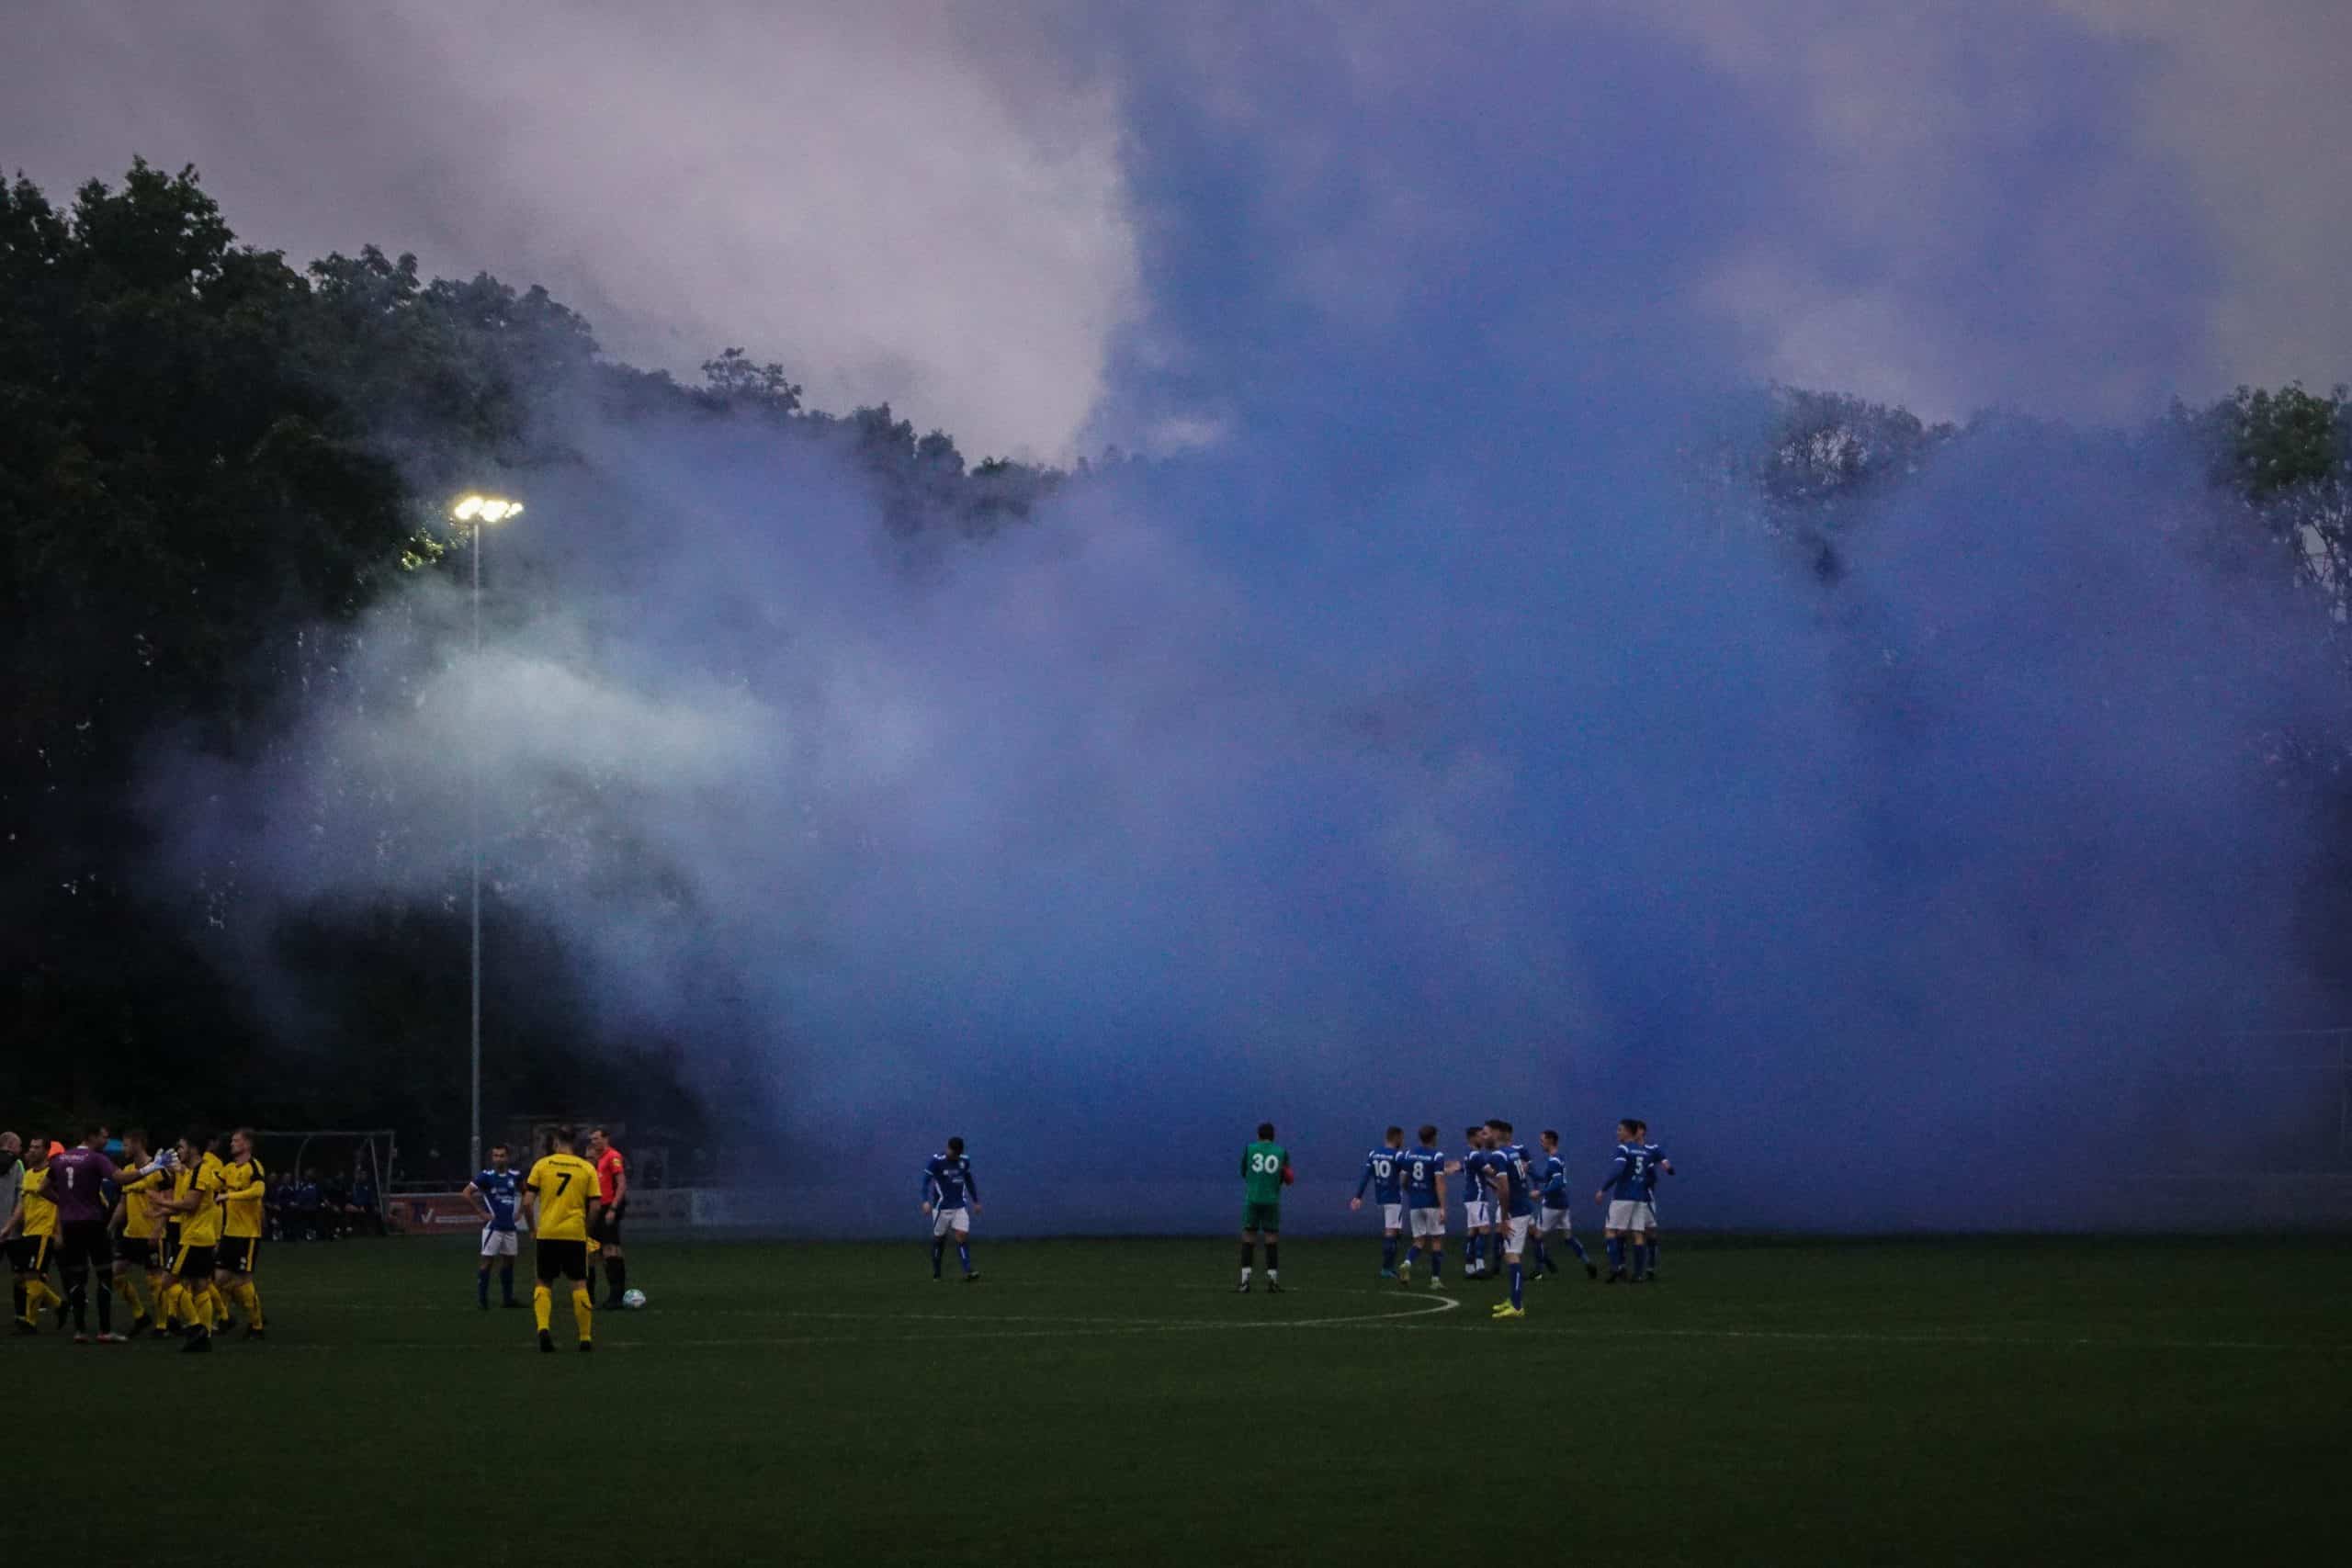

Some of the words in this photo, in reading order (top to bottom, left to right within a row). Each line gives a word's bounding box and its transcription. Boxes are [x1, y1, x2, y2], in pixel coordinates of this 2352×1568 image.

[1251, 1153, 1279, 1174] 30
[1373, 1160, 1391, 1178] 10
[1412, 1161, 1424, 1181] 8
[1634, 1156, 1644, 1174] 5
[66, 1166, 74, 1190] 1
[556, 1172, 571, 1196] 7
